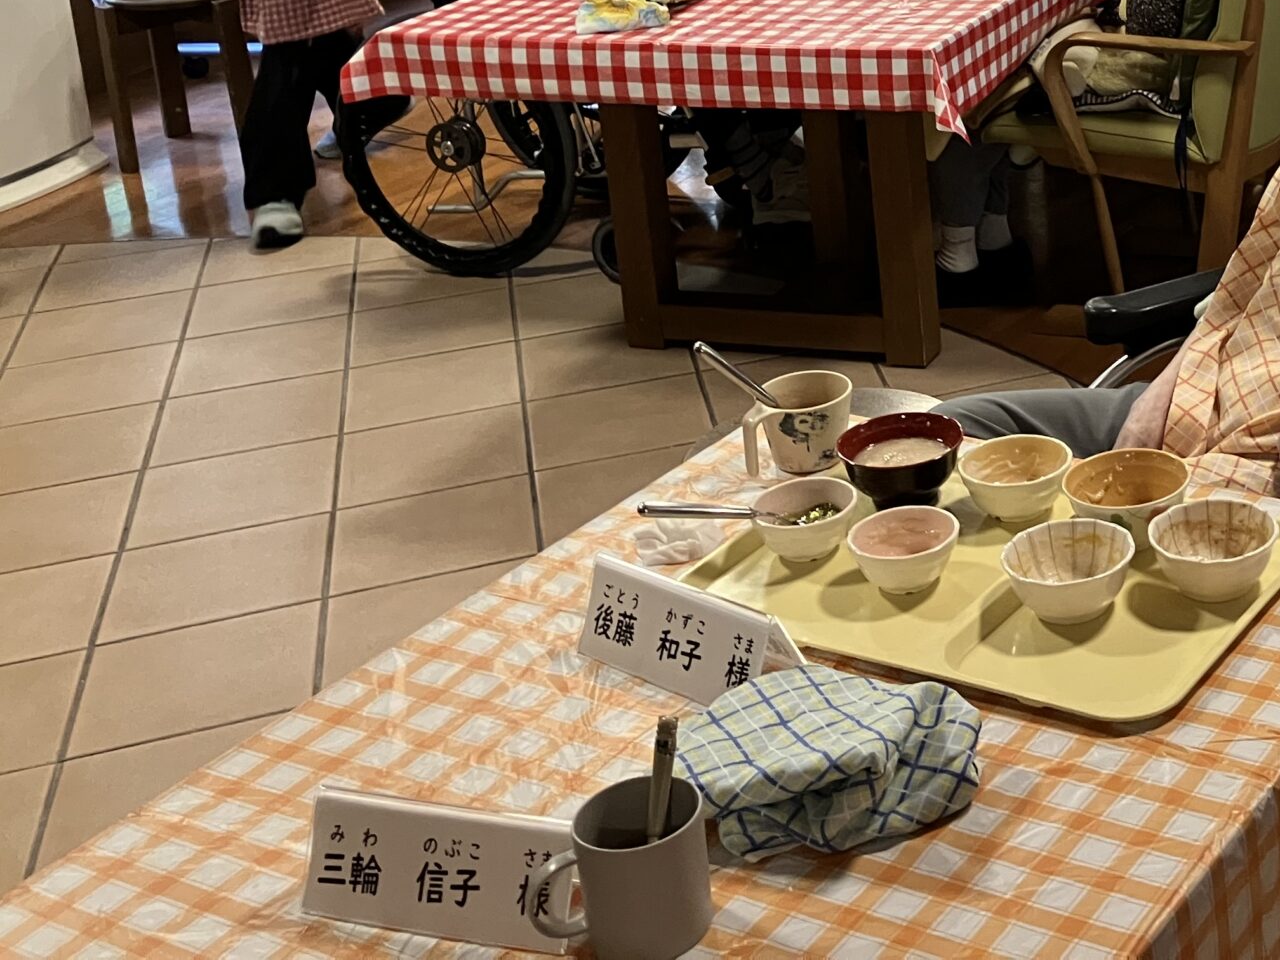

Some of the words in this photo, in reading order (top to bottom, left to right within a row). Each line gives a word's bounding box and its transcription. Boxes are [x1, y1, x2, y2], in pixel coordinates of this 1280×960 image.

[594, 603, 638, 647] 後藤
[656, 629, 702, 672] 和子
[724, 654, 751, 688] 様
[603, 583, 640, 610] ごとう
[665, 608, 706, 635] かずこ
[733, 633, 755, 654] さま
[330, 824, 379, 848] みわ
[423, 837, 481, 860] のぶこ
[317, 852, 383, 897] 三輪
[416, 861, 481, 908] 信子
